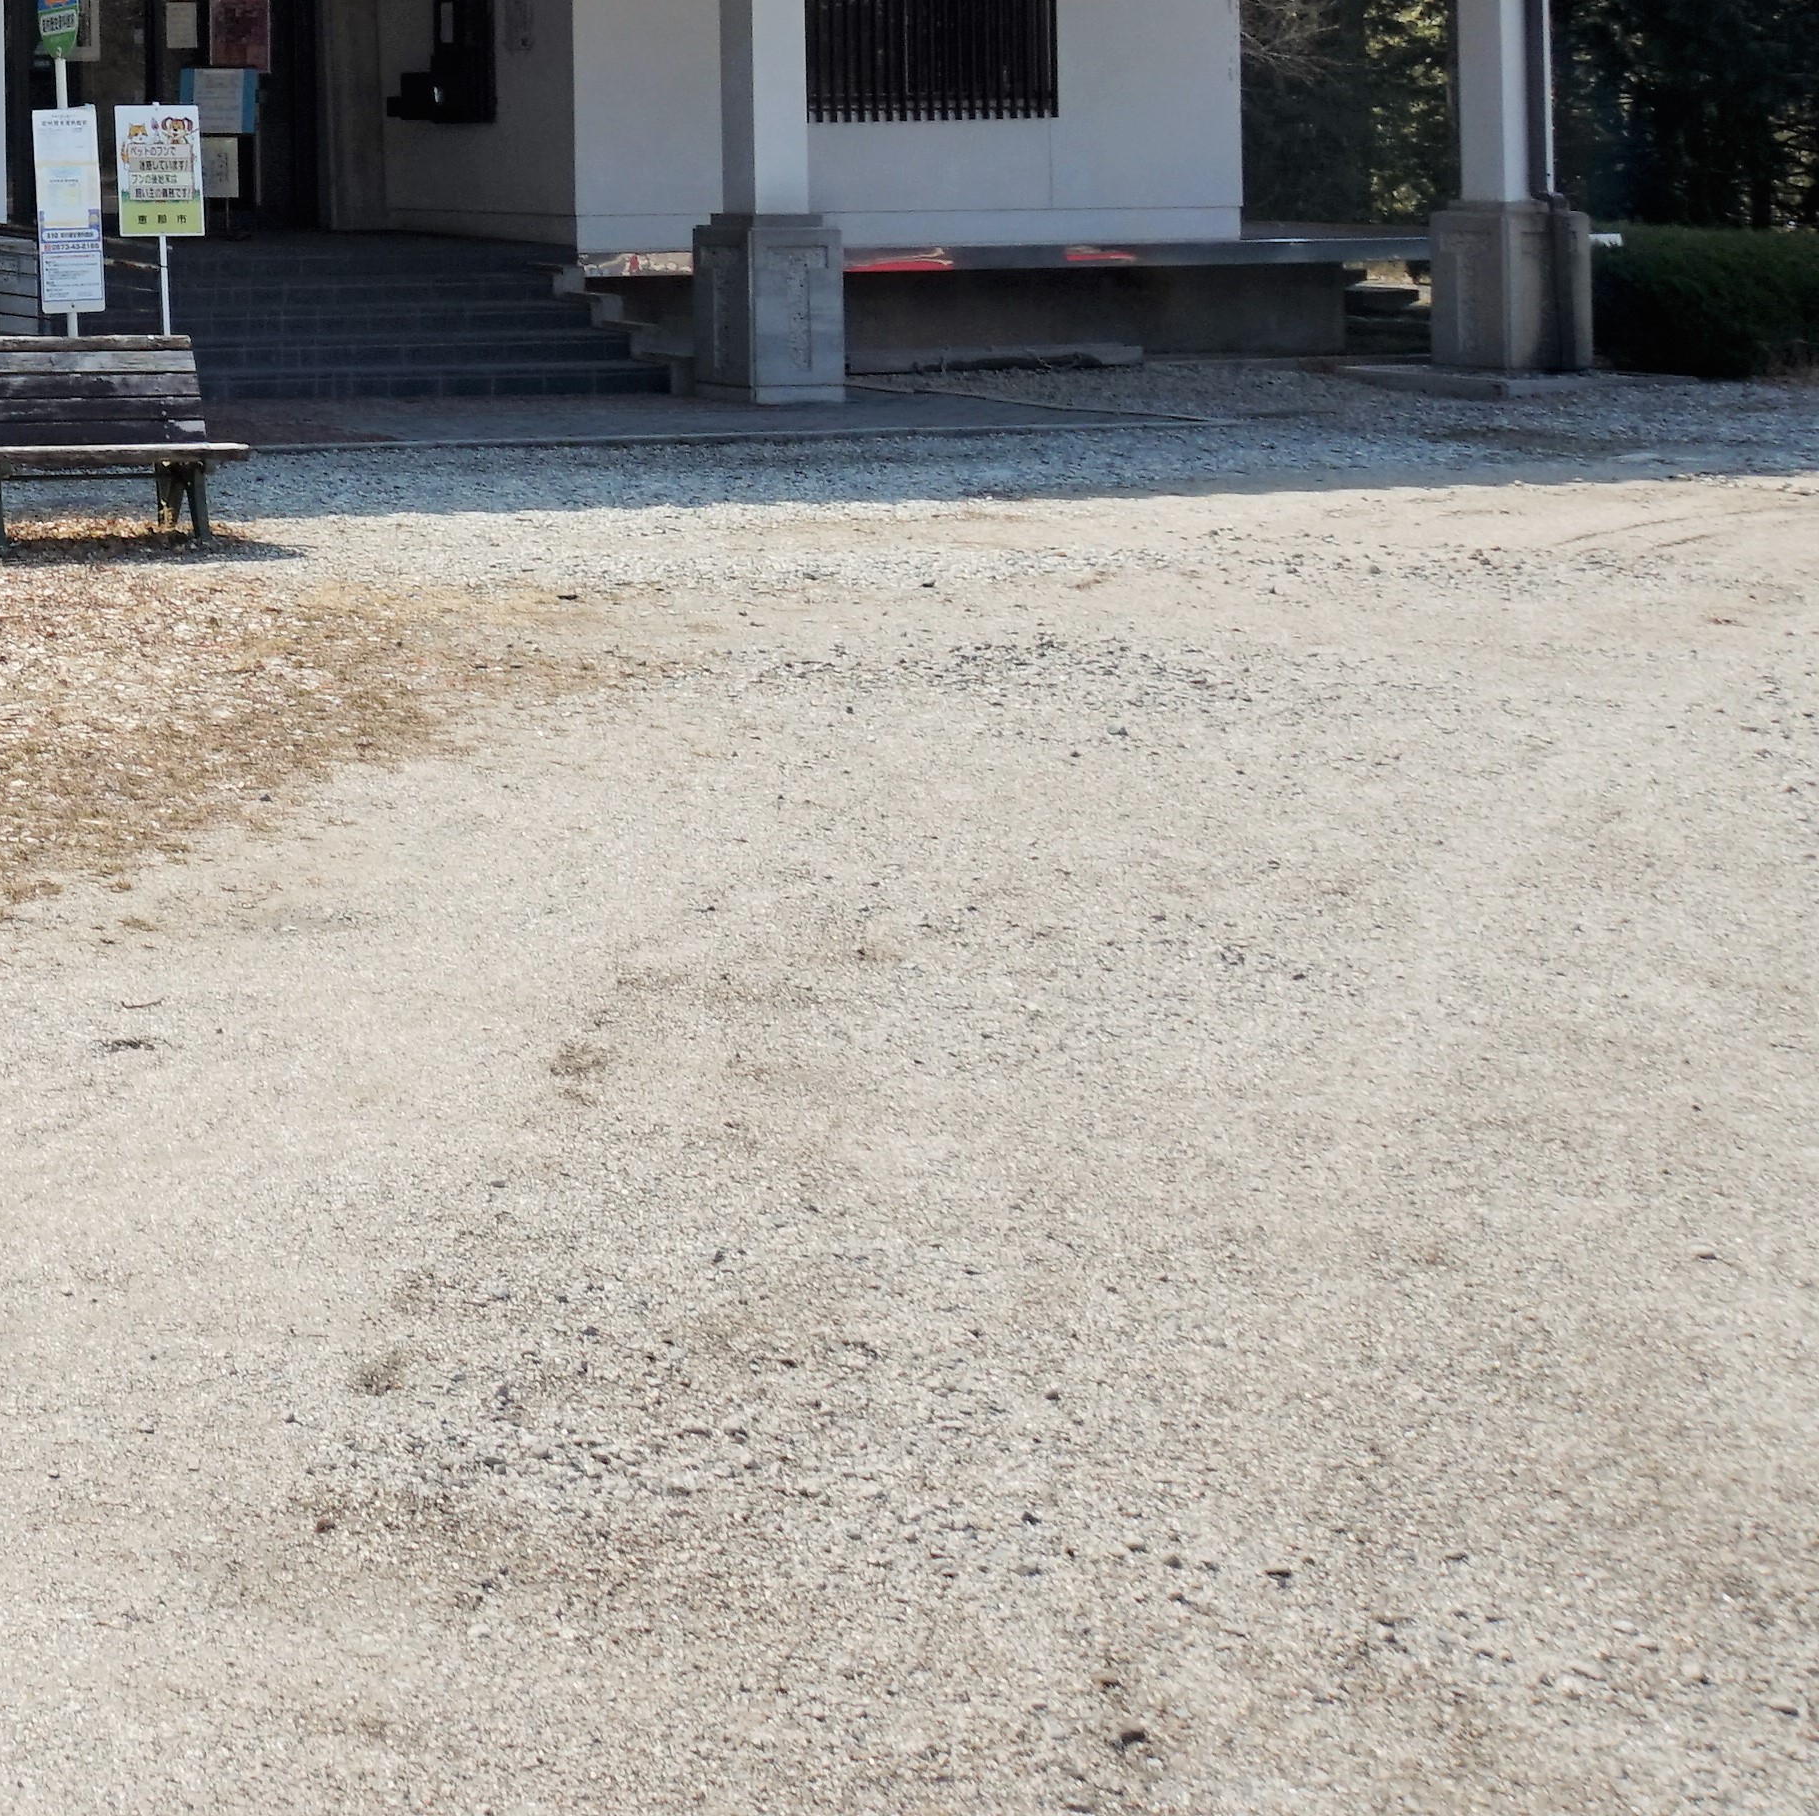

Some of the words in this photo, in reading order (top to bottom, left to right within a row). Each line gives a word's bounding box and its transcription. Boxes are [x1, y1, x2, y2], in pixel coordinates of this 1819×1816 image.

[130, 146, 176, 157] ペットのフンで
